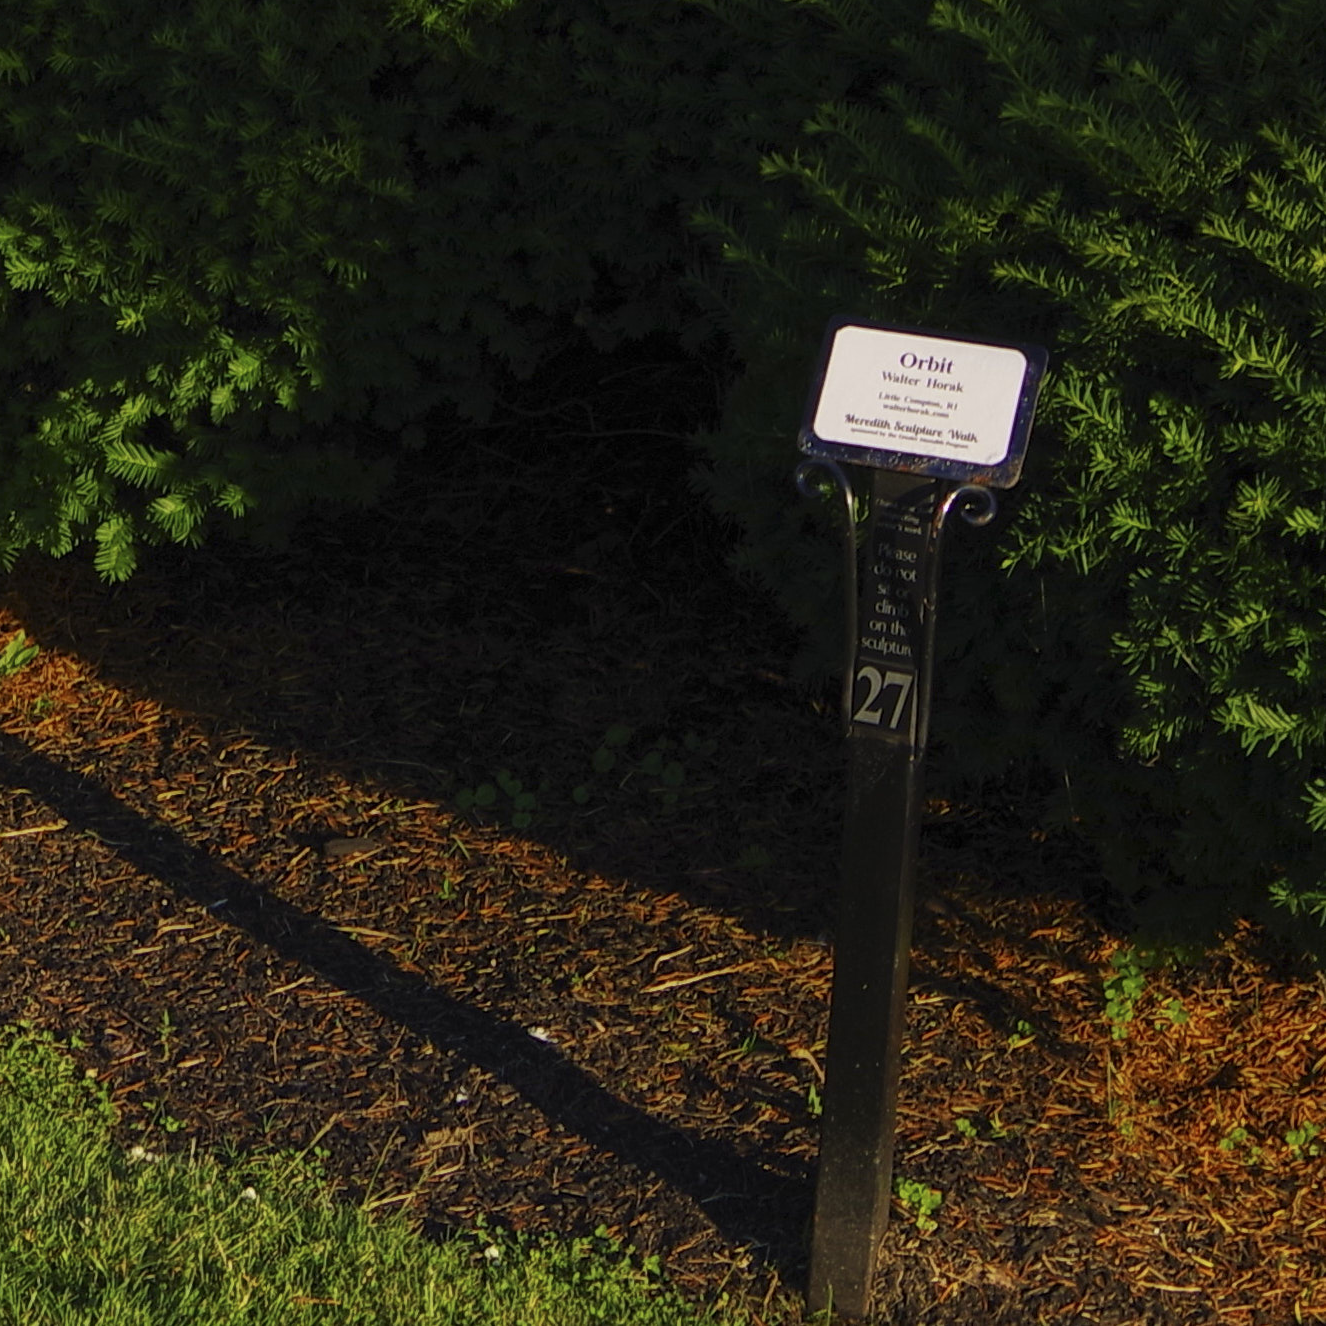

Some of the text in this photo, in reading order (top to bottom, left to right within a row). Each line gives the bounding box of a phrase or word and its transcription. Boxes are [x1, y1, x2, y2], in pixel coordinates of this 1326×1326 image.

[899, 352, 955, 375] Orbit
[881, 371, 964, 393] Walter Horak
[844, 412, 979, 444] Meredith Sculpture Walk
[878, 542, 918, 563] Please
[873, 560, 918, 583] do not
[875, 598, 909, 618] climb
[869, 619, 907, 636] on th
[861, 635, 912, 657] sculptur
[853, 665, 914, 730] 27
